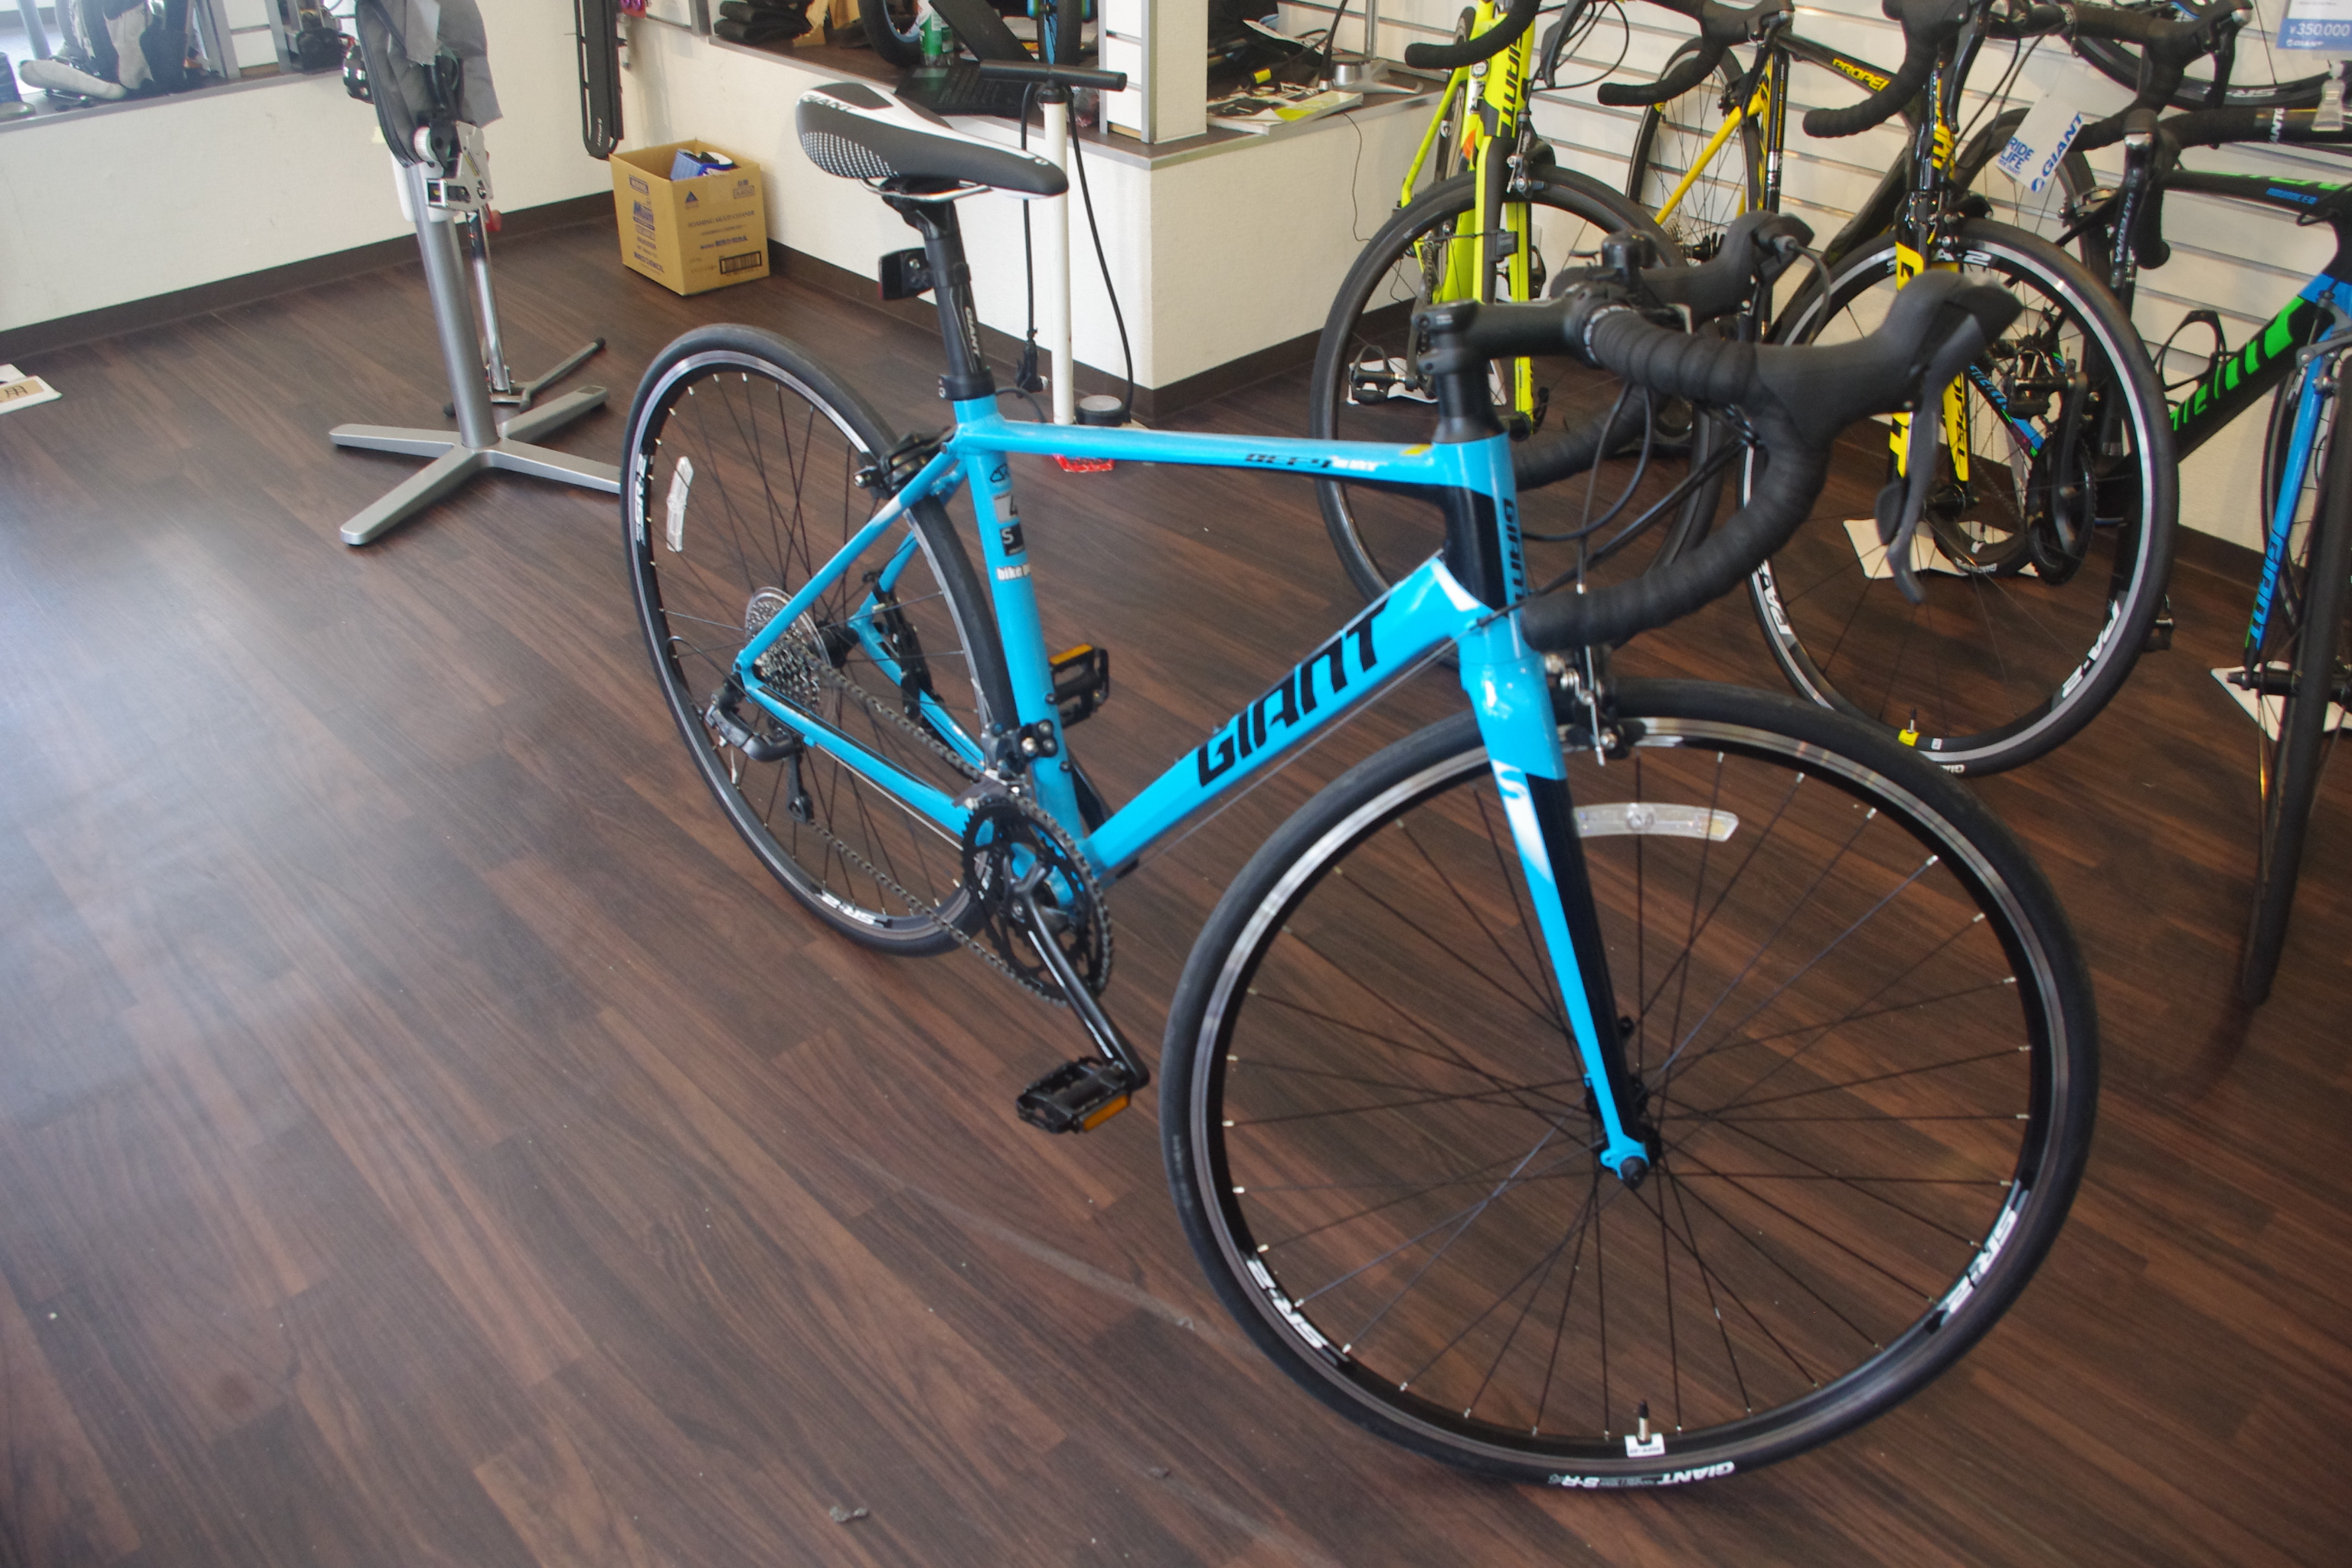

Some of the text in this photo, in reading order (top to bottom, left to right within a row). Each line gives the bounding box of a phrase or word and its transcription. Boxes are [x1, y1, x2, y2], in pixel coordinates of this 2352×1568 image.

[1999, 148, 2025, 170] LIFE
[2007, 136, 2034, 162] RIDE
[2041, 113, 2082, 177] GIANT
[1197, 599, 1389, 788] GIANT
[1246, 1259, 1329, 1351] SR-2
[1657, 1461, 1736, 1486] GIANT
